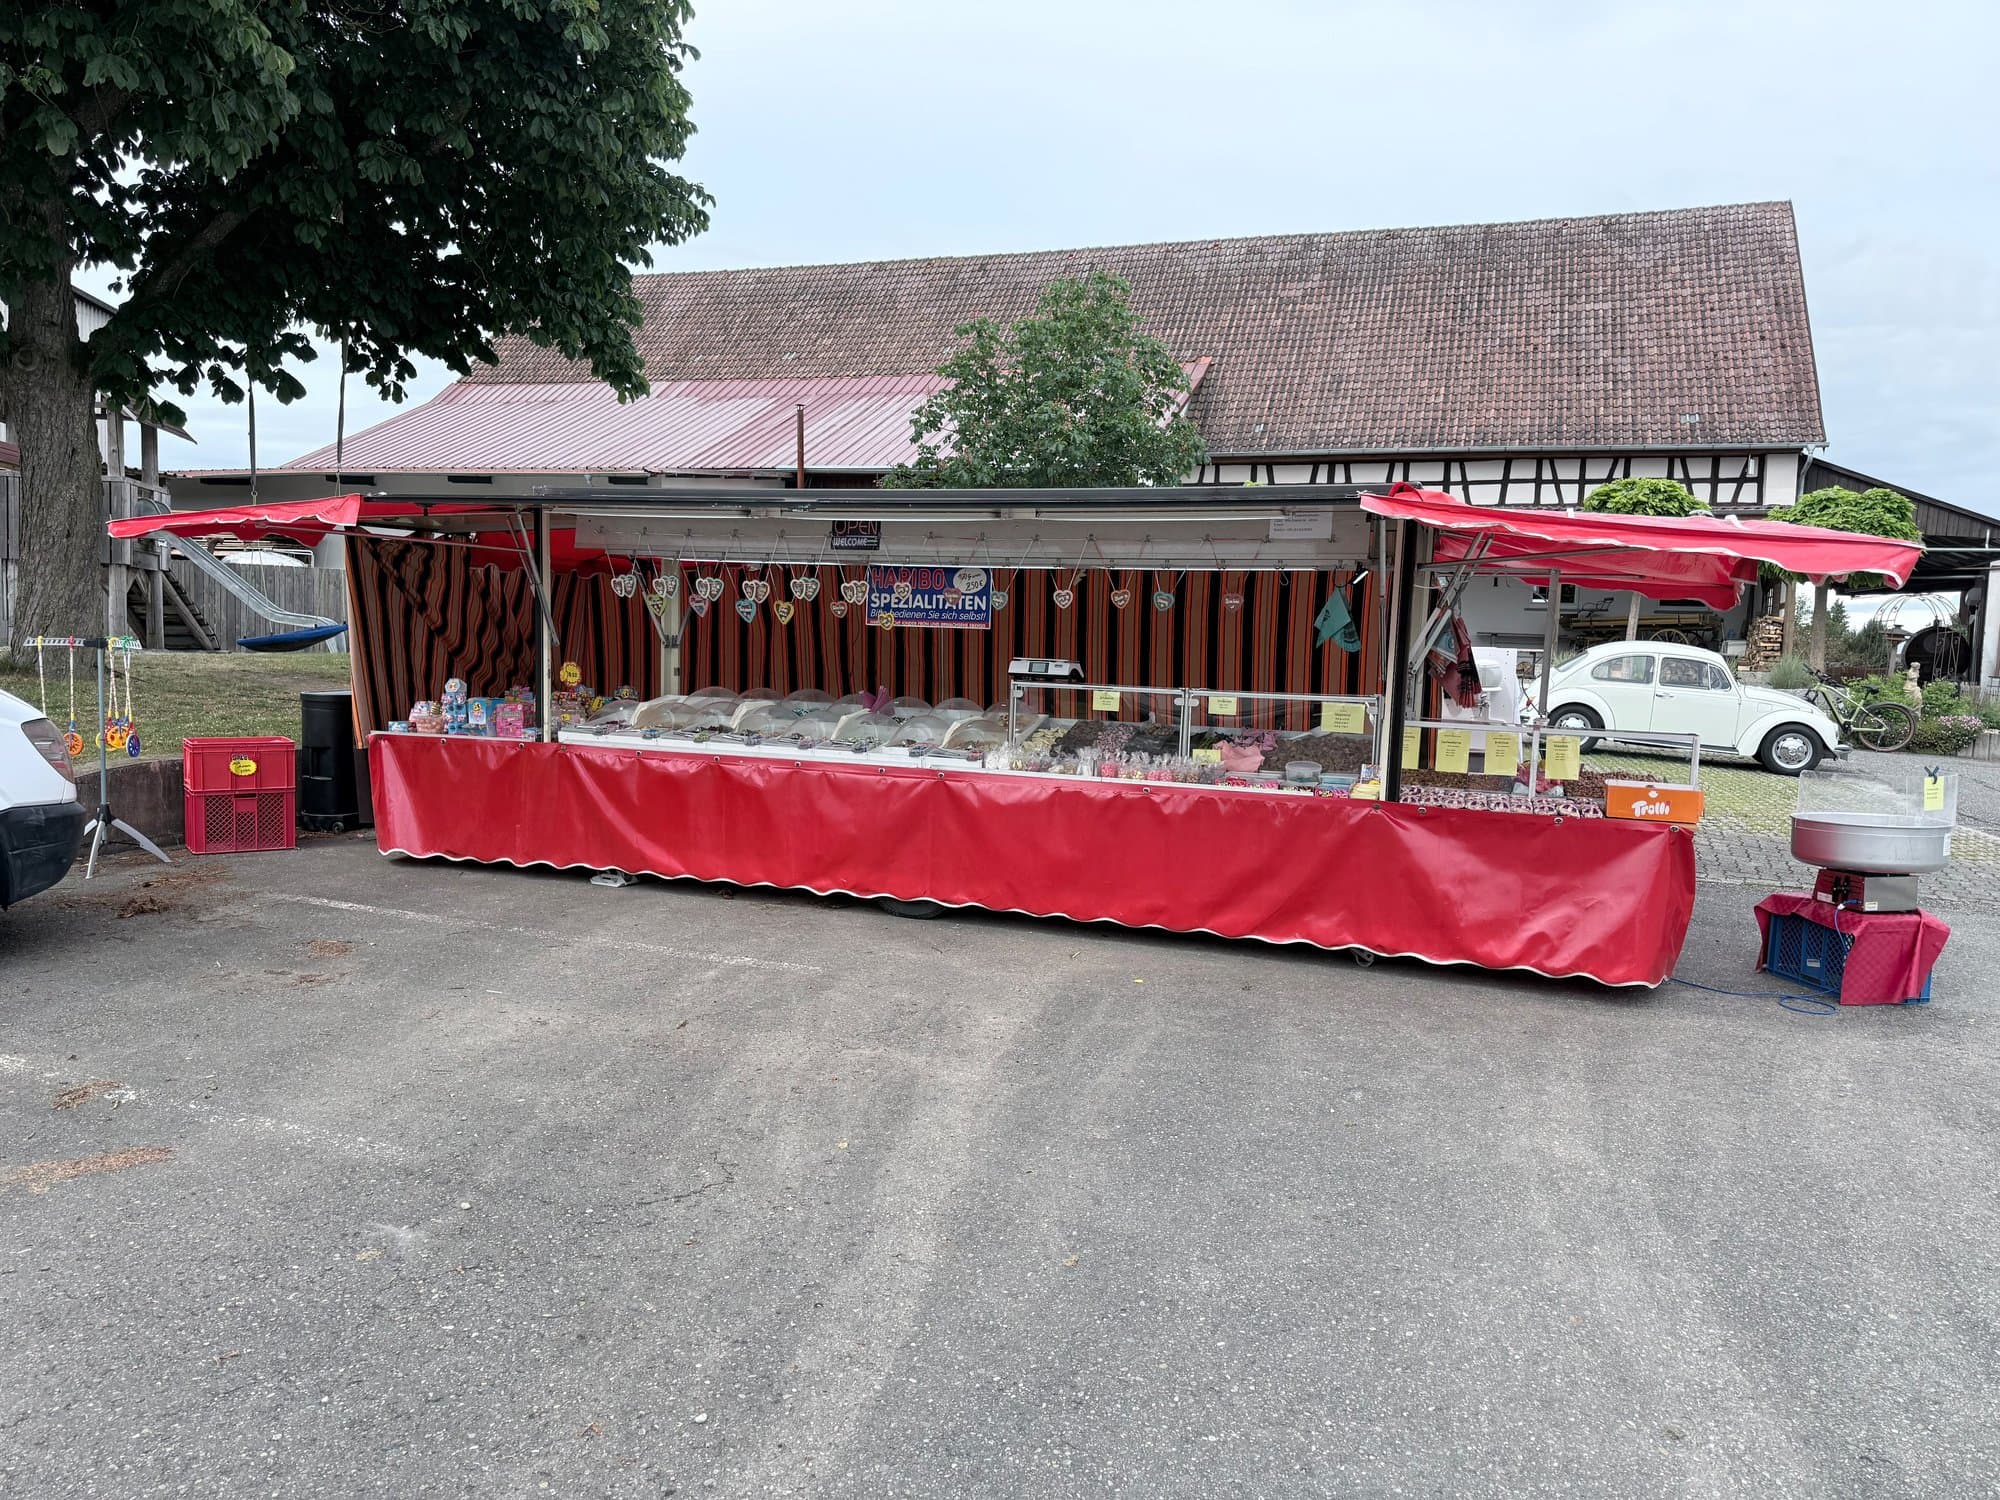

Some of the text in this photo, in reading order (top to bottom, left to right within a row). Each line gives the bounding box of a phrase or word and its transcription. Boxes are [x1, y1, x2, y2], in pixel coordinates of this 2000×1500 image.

[835, 520, 878, 535] OPEN
[833, 537, 868, 547] WELCOME
[871, 568, 945, 590] HARIBO
[870, 592, 987, 611] SPEZIALITTEN
[889, 608, 926, 619] bedienen
[927, 610, 940, 619] Sie
[941, 611, 958, 620] sich
[959, 611, 987, 621] selbst!
[1631, 800, 1671, 818] Trolli
